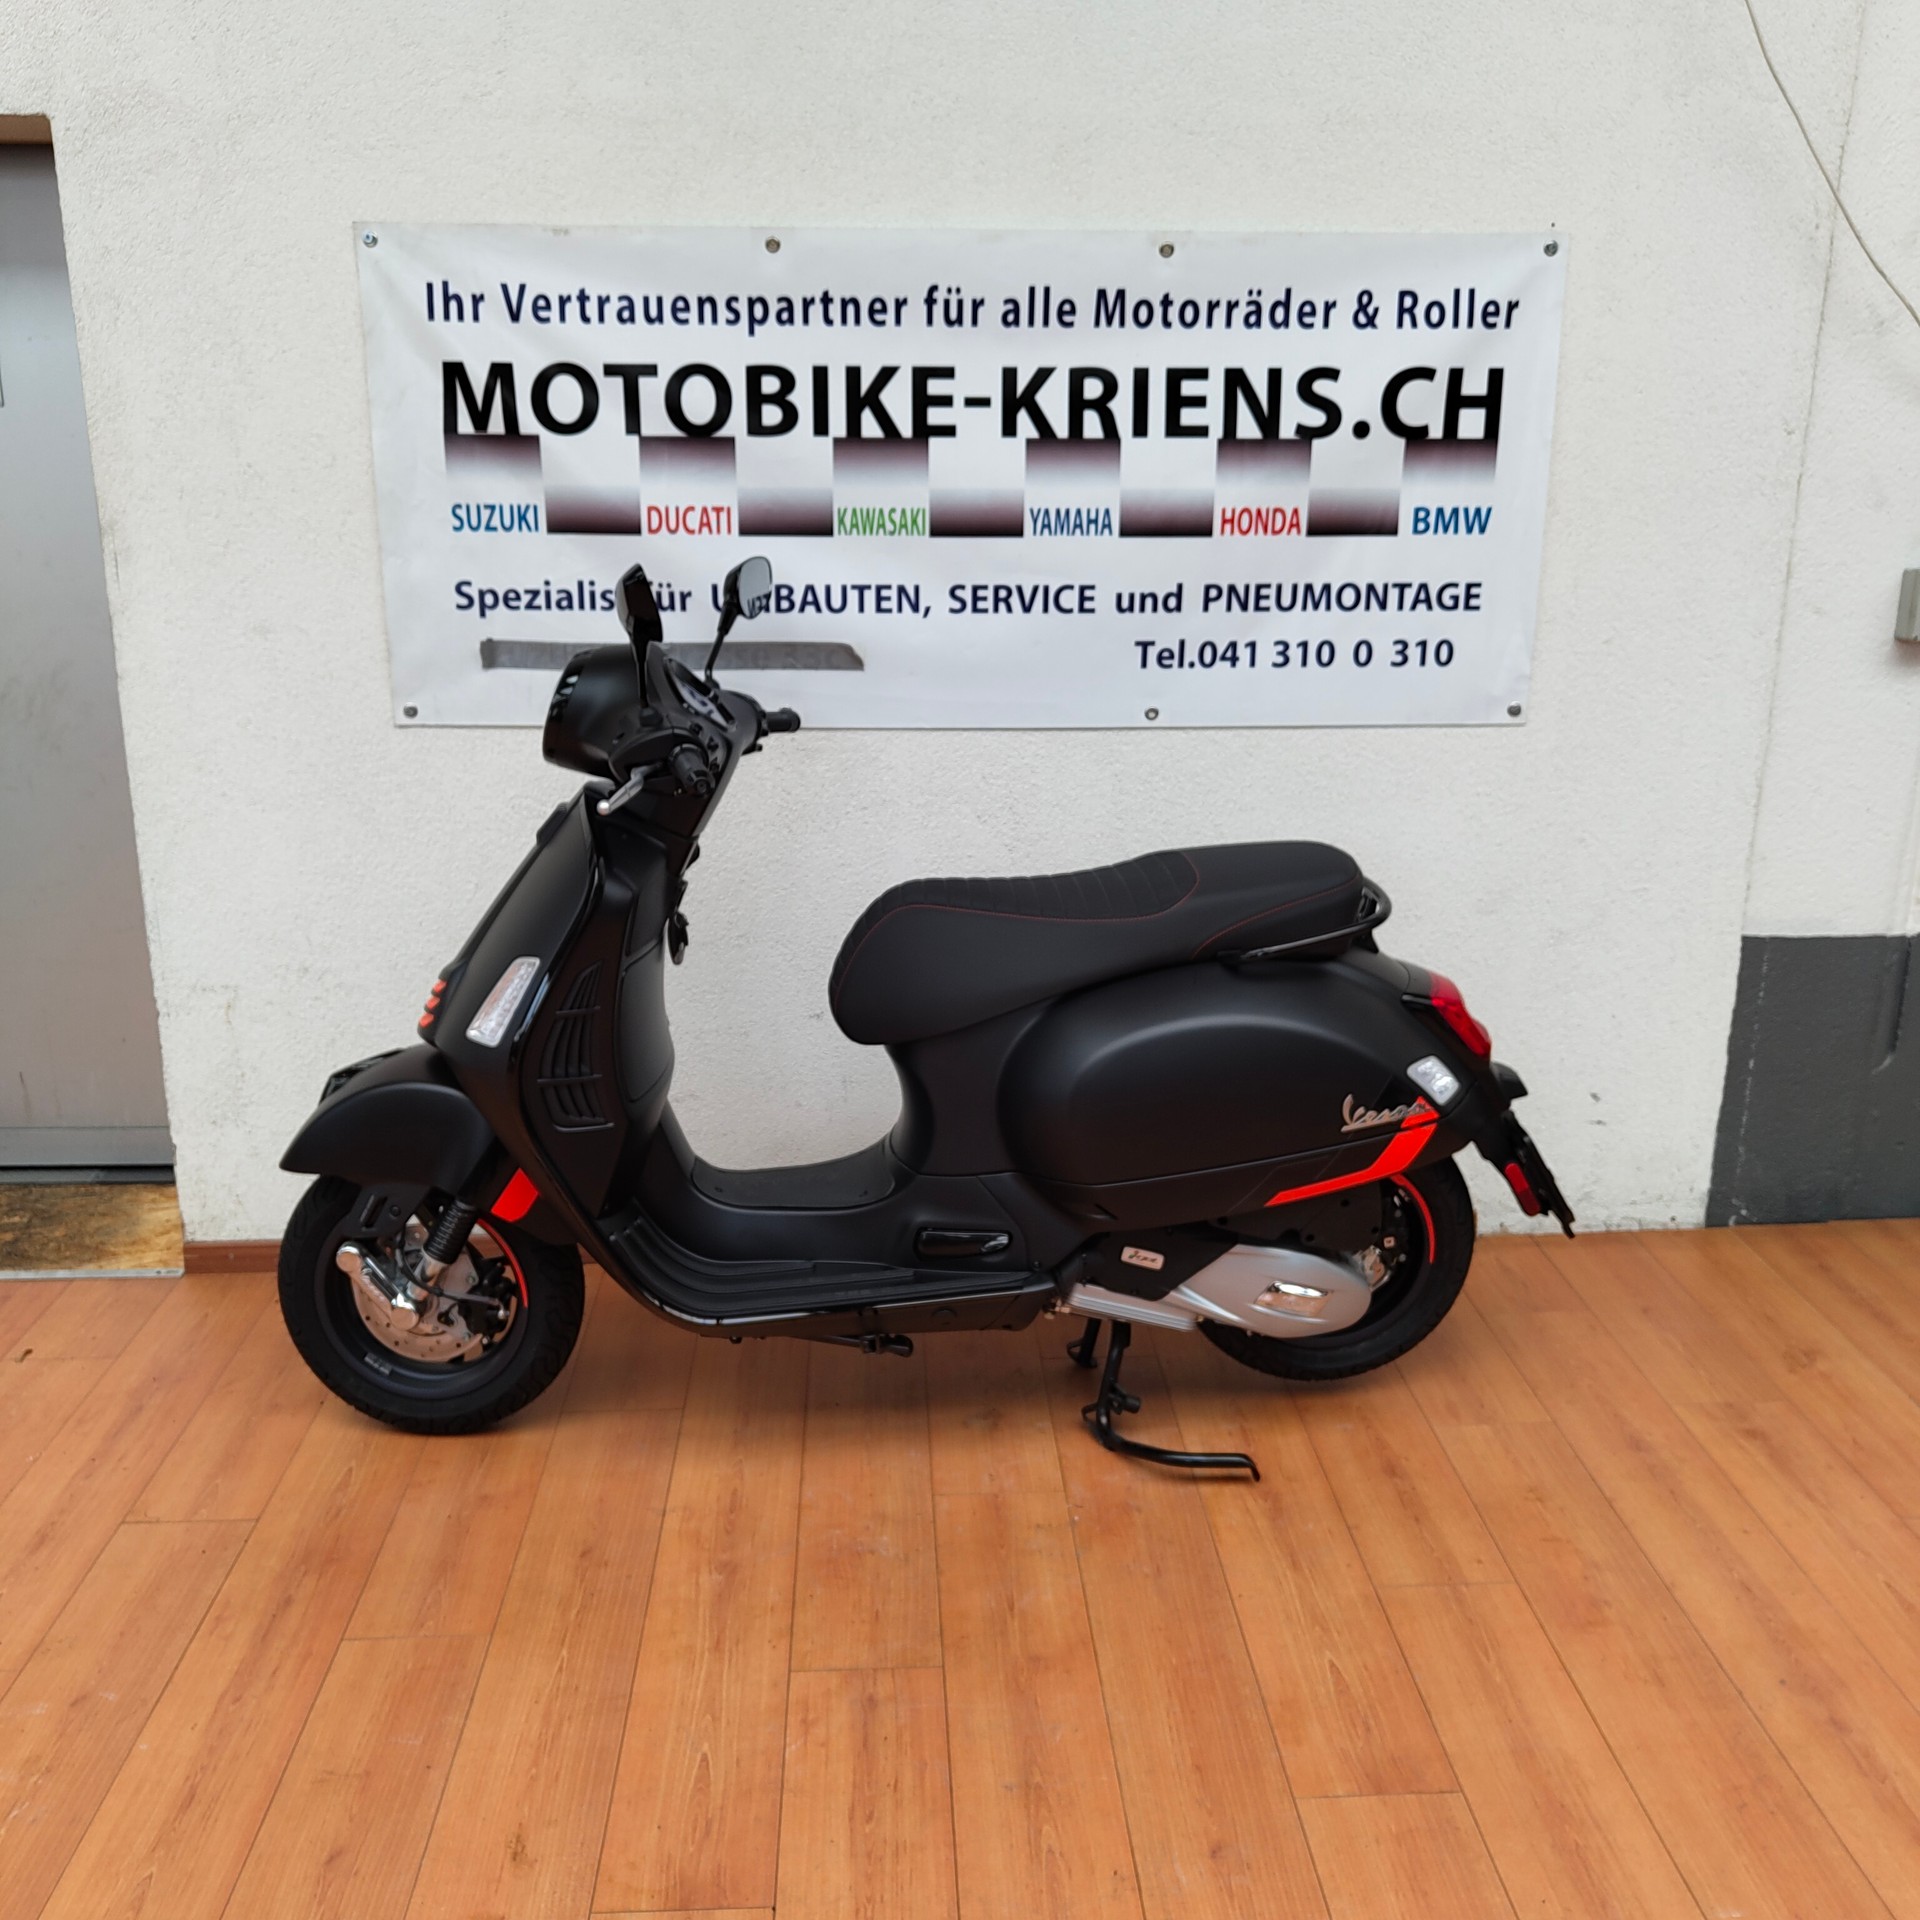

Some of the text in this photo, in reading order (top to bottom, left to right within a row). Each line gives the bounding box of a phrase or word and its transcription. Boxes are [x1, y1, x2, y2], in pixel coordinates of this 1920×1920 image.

[425, 280, 1521, 336] Ihr Vertrauenspartner für alle Motorräder & Roller
[442, 360, 1505, 441] MOTOBIKE-KRIENS.CH
[451, 503, 540, 533] SUZUKI
[646, 505, 732, 536] DUCATI
[836, 507, 927, 537] KAWASAKI
[1029, 507, 1114, 537] YAMAHA
[1219, 507, 1301, 536] HONDA
[1411, 507, 1493, 535] BMW
[454, 581, 1483, 618] Spezialis ür UBAUTEN, SERVICE und PNEUMONTAGE
[1134, 639, 1455, 669] Tel.041 310 0 310
